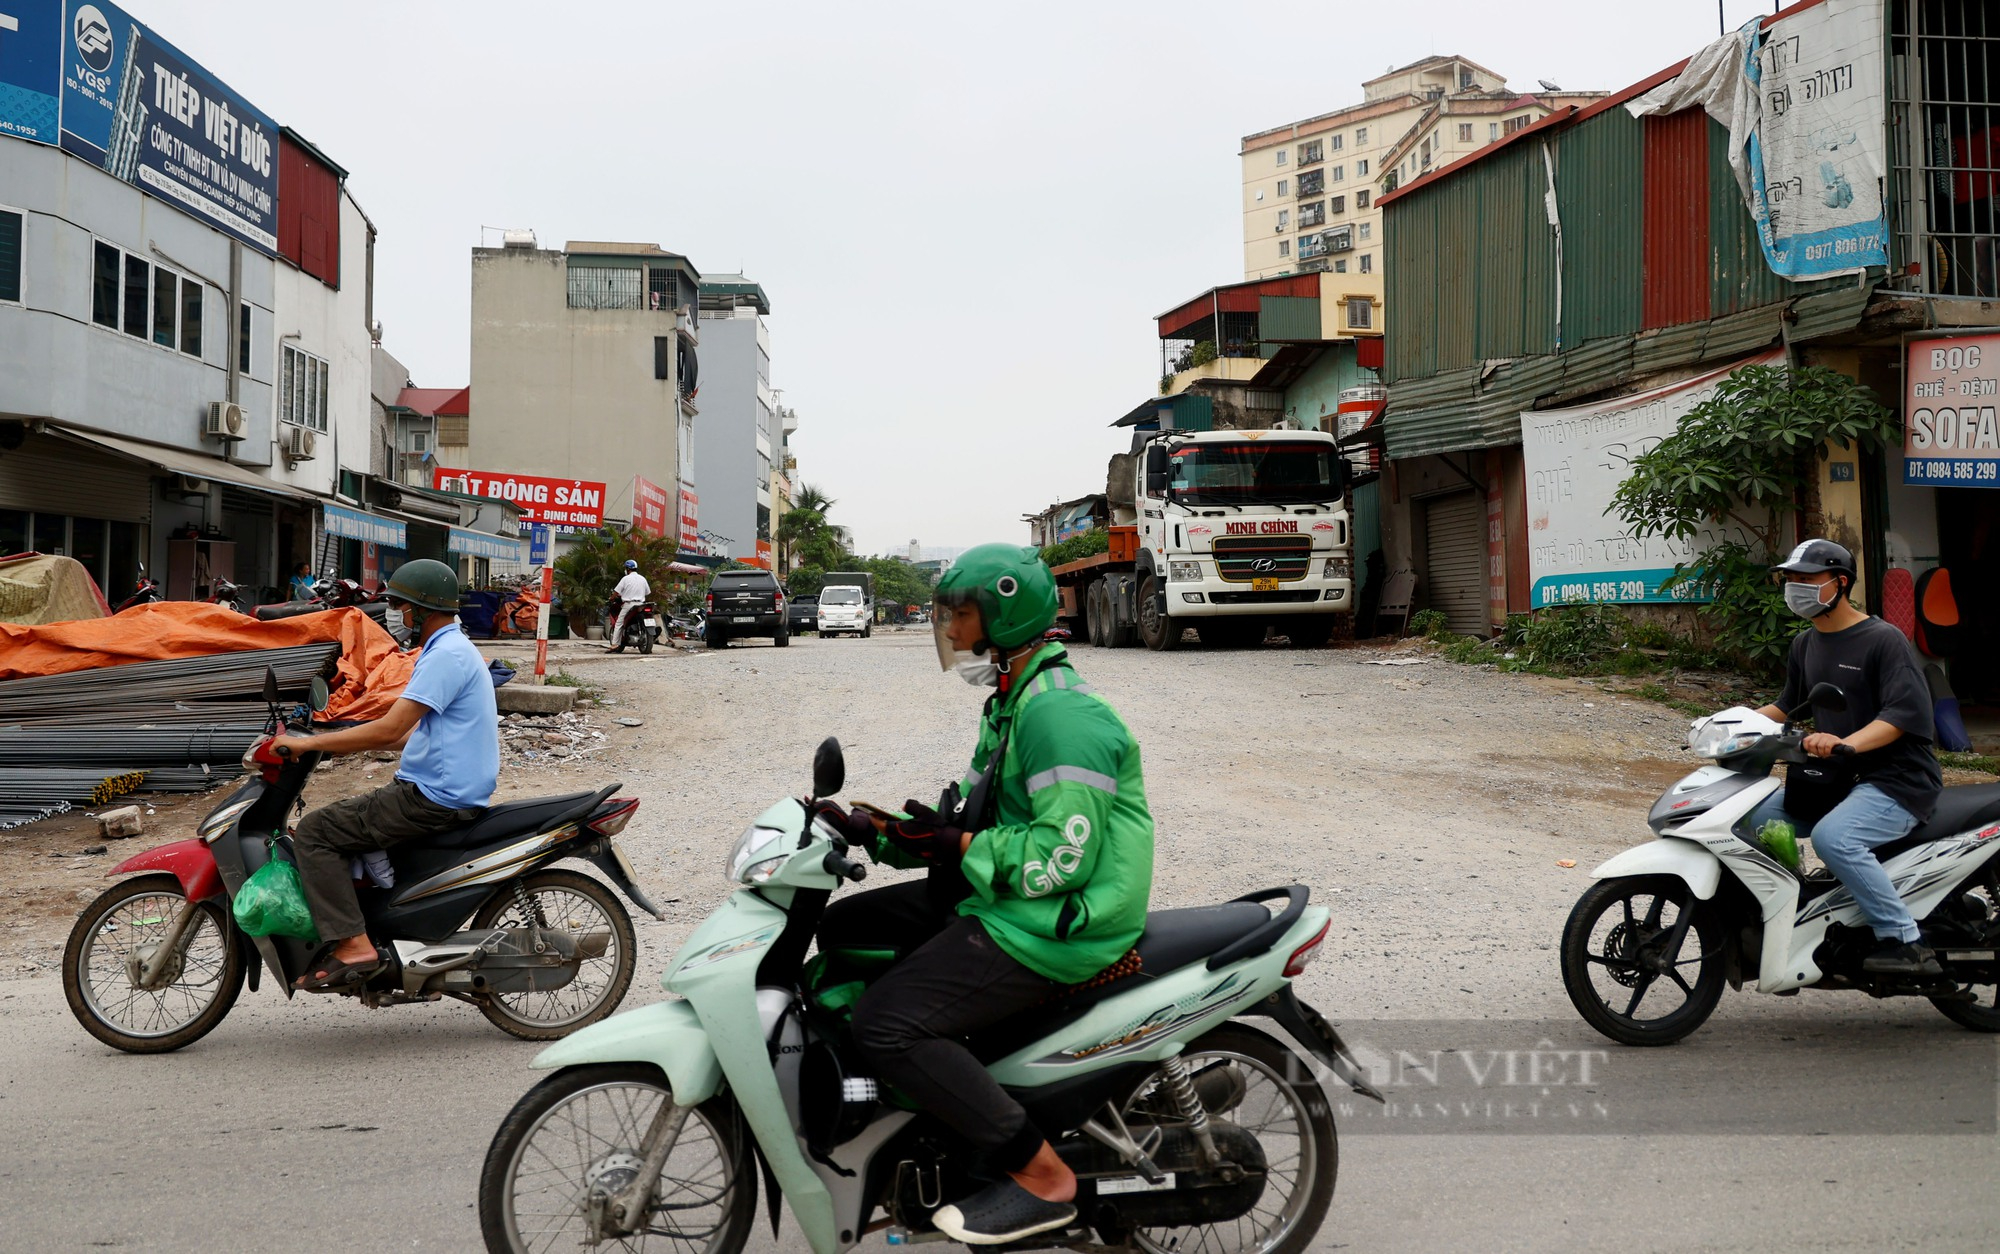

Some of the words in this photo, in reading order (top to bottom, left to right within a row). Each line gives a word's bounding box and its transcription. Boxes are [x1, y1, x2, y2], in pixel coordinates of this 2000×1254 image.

[66, 77, 78, 90] ISO
[81, 86, 95, 101] 9001
[99, 96, 113, 111] 2015
[153, 62, 200, 129] THÉP
[204, 96, 238, 160] VIỆT
[240, 122, 271, 178] ĐỨC
[151, 122, 172, 157] CÔNG
[173, 137, 183, 161] TY
[183, 143, 201, 174] TNHH
[201, 154, 211, 179] ĐT
[211, 160, 220, 184] TM
[220, 163, 229, 190] VÀ
[229, 171, 239, 195] DV
[239, 177, 254, 205] MINH
[254, 187, 271, 215] CHÍNH
[164, 160, 188, 183] CHUYÊN
[189, 173, 203, 190] KINH
[203, 182, 223, 202] DOANH
[223, 192, 236, 208] THÉP
[1806, 241, 1832, 260] 0977
[1835, 237, 1857, 255] 806
[1930, 345, 1982, 375] BỌC
[1913, 376, 1947, 398] GHẾ
[1959, 376, 1998, 399] ĐỆM
[1911, 405, 2000, 450] SOFA
[1909, 461, 1924, 478] ĐT:
[1926, 461, 1951, 479] 0984
[1953, 462, 1974, 479] 585
[1976, 462, 1997, 480] 299
[554, 480, 600, 508] SẢN
[543, 510, 567, 523] ĐỊNH
[569, 511, 597, 525] CÔNG
[1226, 521, 1257, 534] MINH
[1260, 518, 1299, 534] CHÍNH
[1542, 585, 1559, 603] ĐT:
[1561, 583, 1590, 602] 0984
[1593, 582, 1617, 601] 585
[1620, 580, 1644, 600] 299
